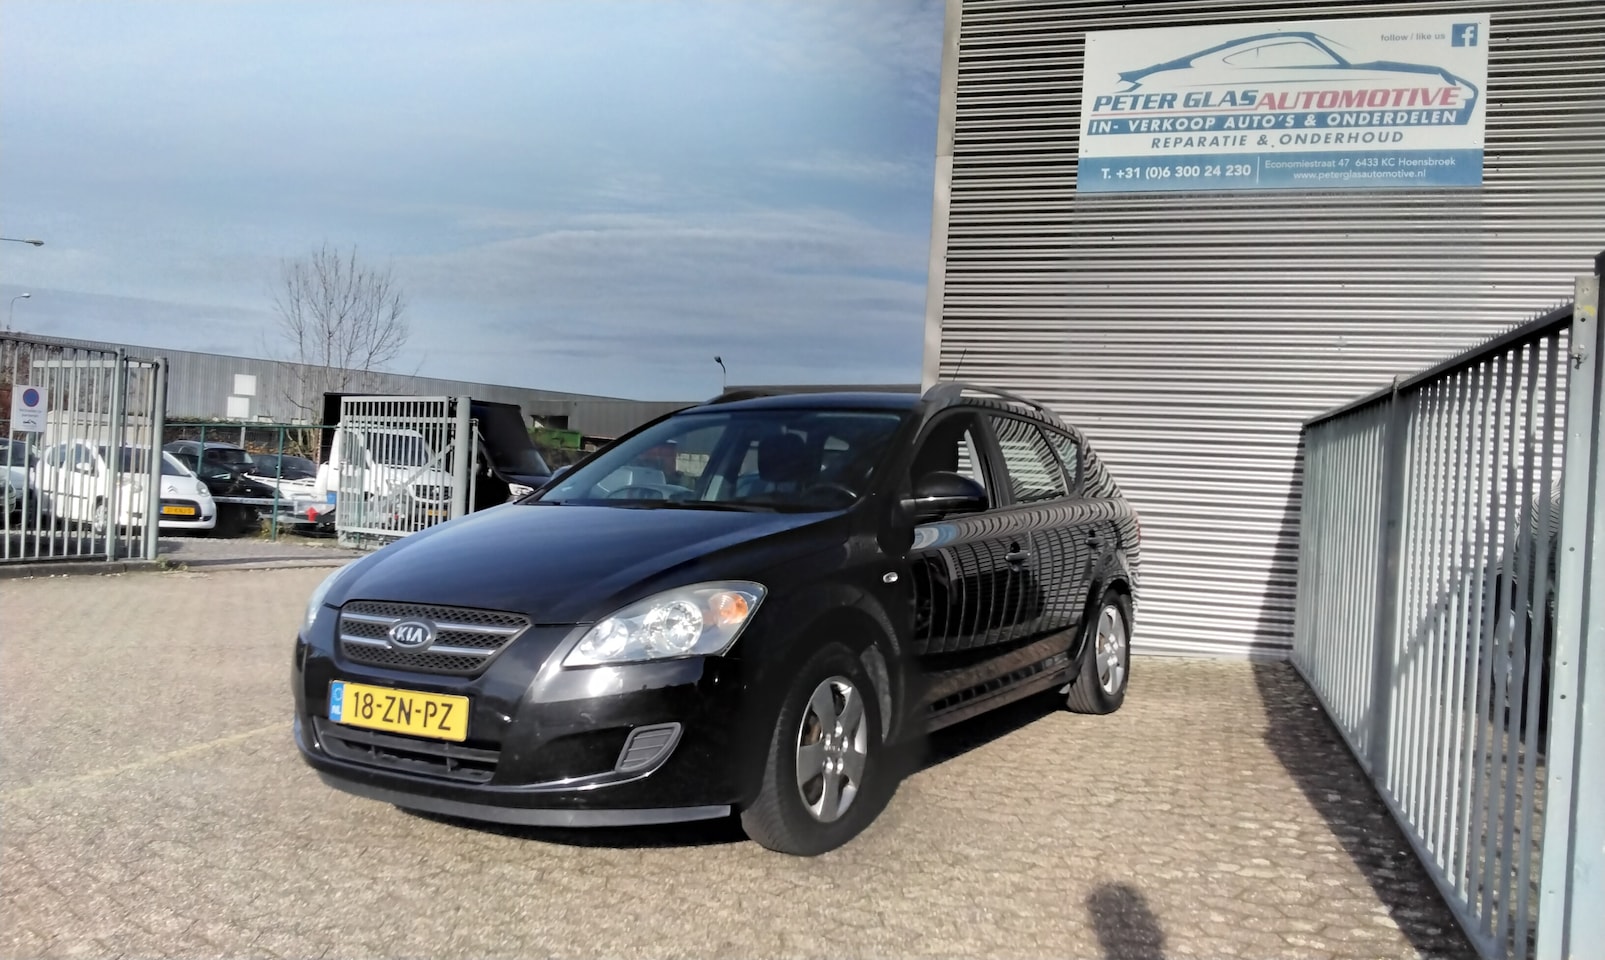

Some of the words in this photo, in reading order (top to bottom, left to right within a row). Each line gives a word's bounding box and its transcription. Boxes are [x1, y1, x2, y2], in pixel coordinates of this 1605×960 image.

[1381, 33, 1408, 41] follow
[1416, 32, 1432, 40] like
[1092, 92, 1178, 112] PETER
[1091, 120, 1119, 134] IN-
[1128, 117, 1216, 132] VERKOOP
[1224, 114, 1295, 129] AUTO'S
[1304, 114, 1317, 126] &
[1327, 110, 1457, 126] ONDERDELEN
[1151, 134, 1248, 149] REPARATIE
[1256, 134, 1268, 146] &
[1279, 131, 1404, 146] ONDERHOUD
[1264, 160, 1336, 168] Economiestraat
[1338, 158, 1350, 166] 47
[1355, 158, 1379, 166] 6433
[1382, 158, 1396, 166] KC
[1398, 157, 1456, 166] Hoensbroek
[1101, 168, 1111, 180] T.
[1116, 167, 1141, 179] +31
[1146, 166, 1171, 180] (0)6
[1175, 166, 1200, 178] 300
[1204, 166, 1222, 176] 24
[1226, 164, 1252, 176] 230
[1294, 169, 1426, 180] www.peterglasautomotive.nl
[396, 626, 422, 643] KIA
[354, 691, 454, 731] 18-ZN-PZ
